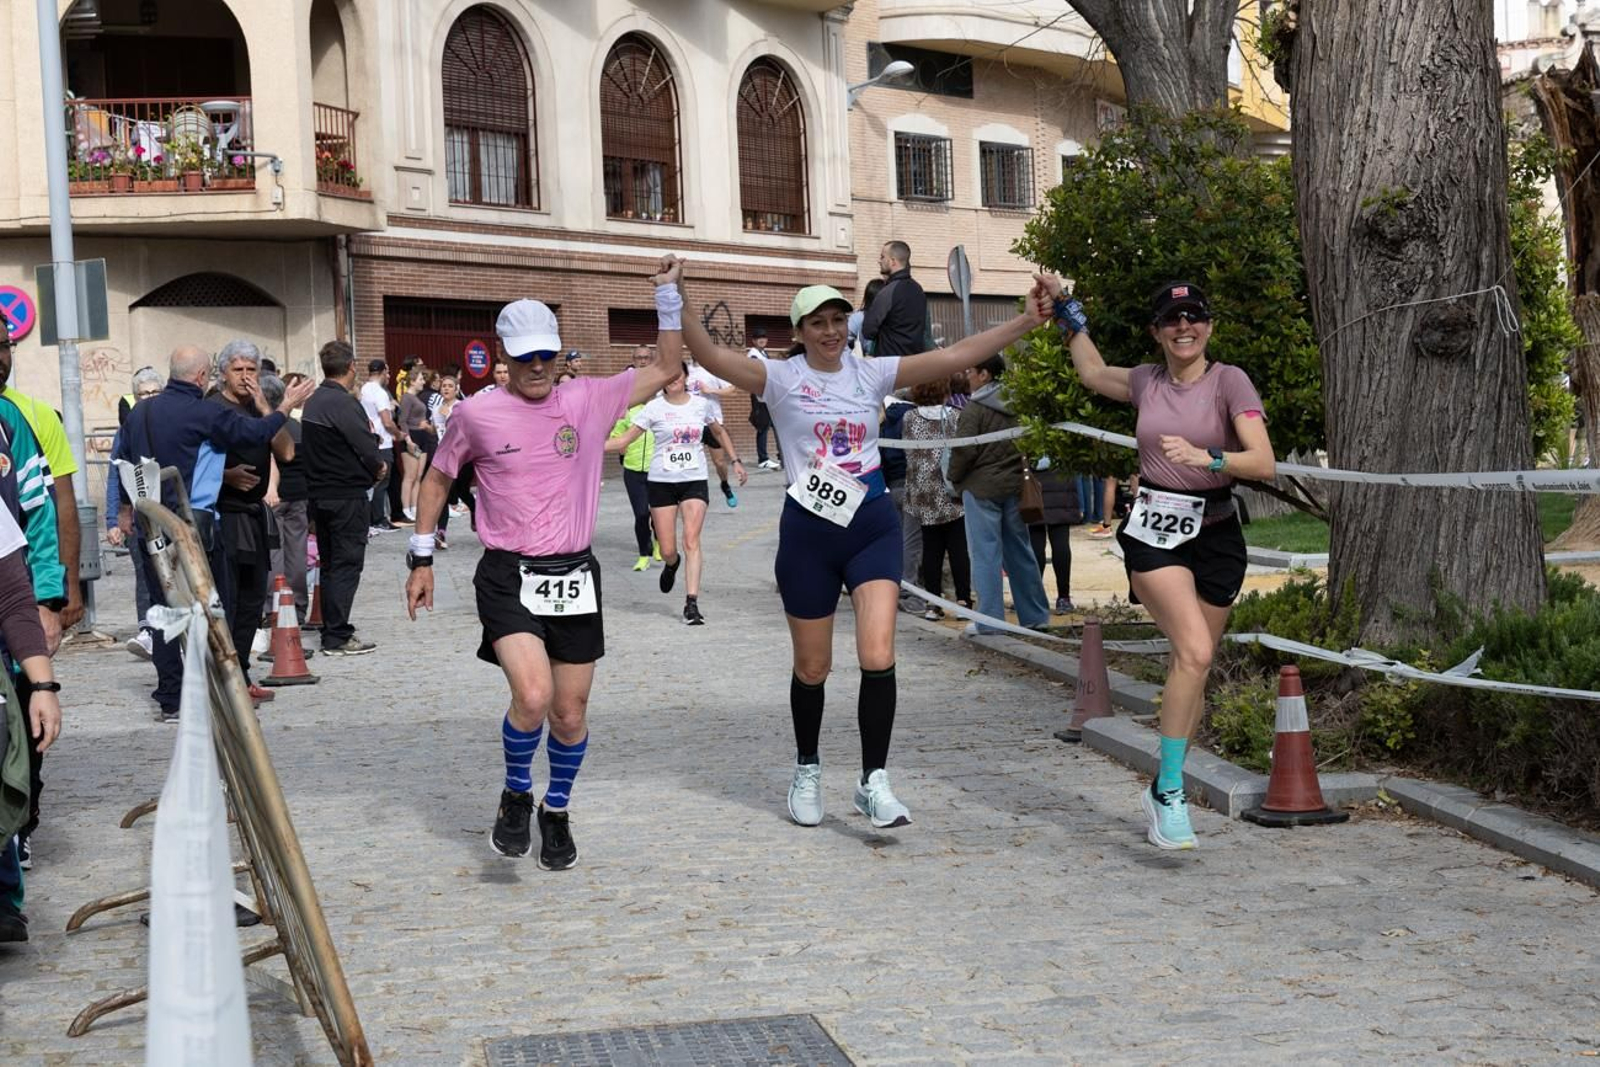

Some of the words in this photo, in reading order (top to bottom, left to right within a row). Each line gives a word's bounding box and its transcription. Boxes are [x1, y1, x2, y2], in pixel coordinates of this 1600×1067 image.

[669, 452, 692, 463] 640
[806, 474, 847, 507] 989
[1140, 509, 1195, 535] 1226
[535, 580, 580, 599] 415
